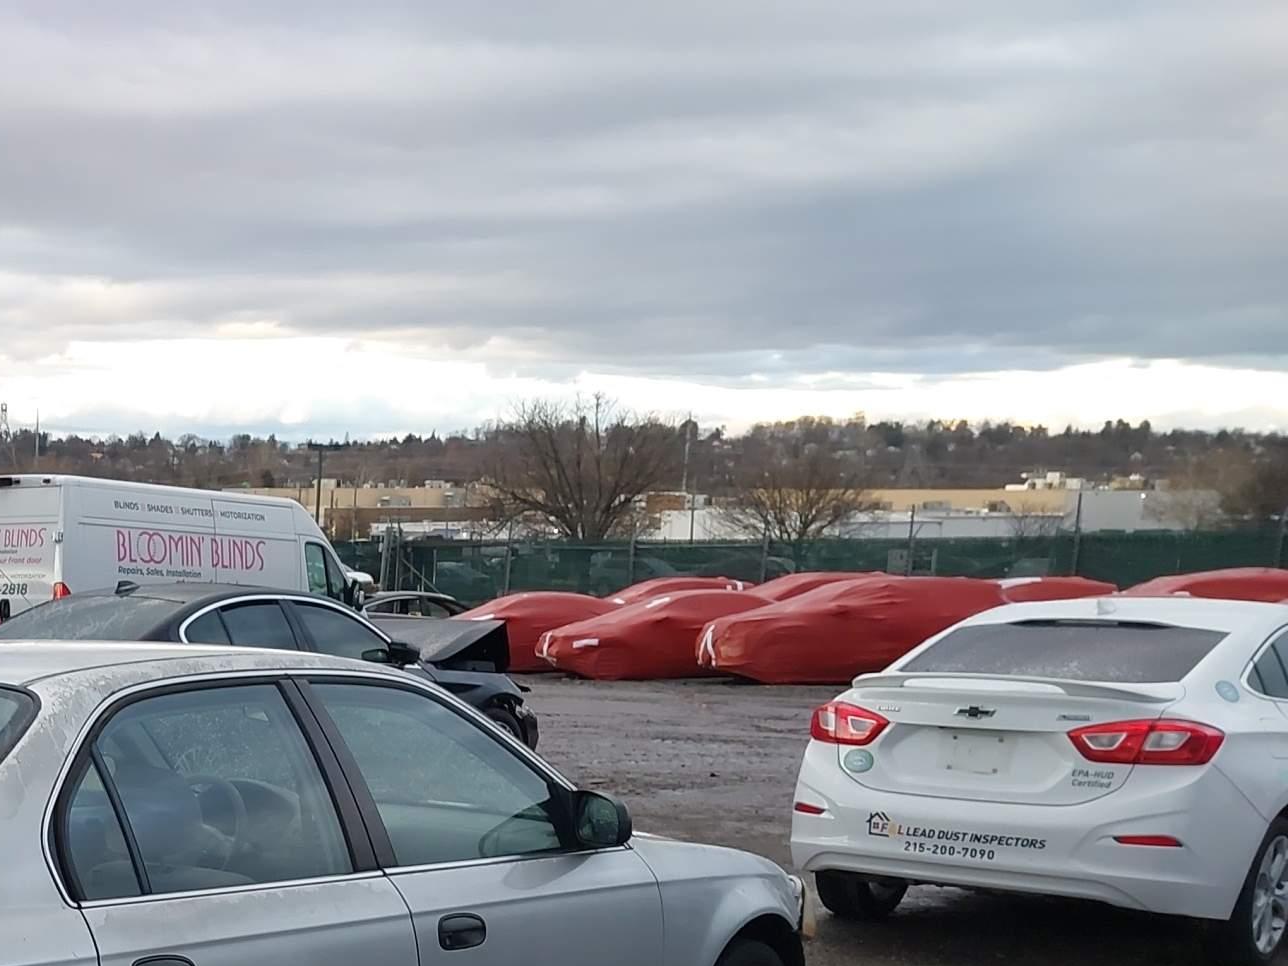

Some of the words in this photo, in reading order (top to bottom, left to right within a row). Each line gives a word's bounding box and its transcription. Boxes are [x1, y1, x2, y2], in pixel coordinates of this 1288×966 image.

[114, 501, 139, 511] BLINDS
[147, 504, 173, 514] SHADES
[181, 507, 213, 517] SHUTTERS
[220, 511, 265, 521] MOTORIZATION
[4, 528, 46, 548] BLINDS
[116, 529, 204, 568] BLOOMIN'
[211, 537, 266, 571] BLINDS
[118, 566, 144, 577] Repairs,
[166, 568, 202, 578] Installation
[1071, 768, 1114, 779] EPA-HUD
[1071, 779, 1112, 788] Certified
[905, 826, 935, 838] LEAD
[937, 830, 968, 842] DUST
[969, 833, 1047, 850] INSPECTORS
[904, 841, 995, 860] 215-200-7090
